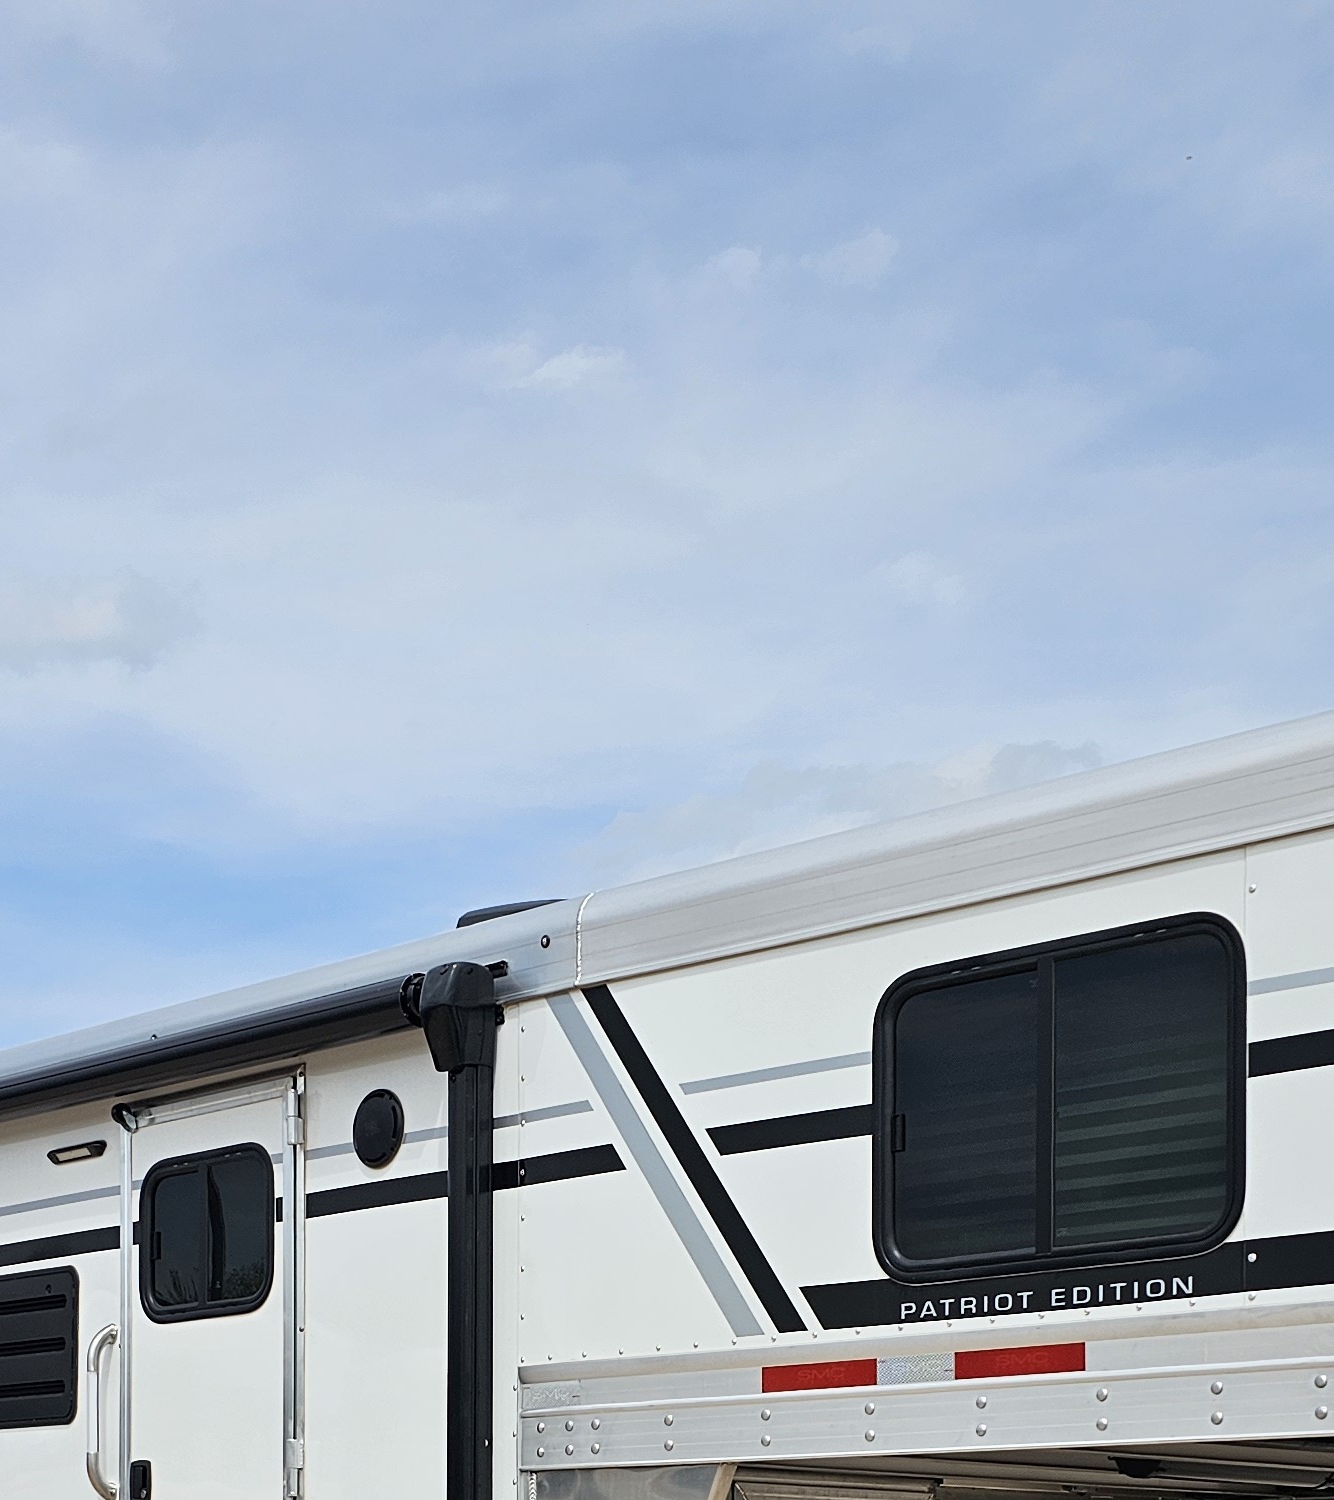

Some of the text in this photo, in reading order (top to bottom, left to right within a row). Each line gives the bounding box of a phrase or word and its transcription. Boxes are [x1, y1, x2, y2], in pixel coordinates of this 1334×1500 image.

[900, 1276, 1194, 1320] PATRIOT EDITION
[797, 1367, 845, 1381] SMC
